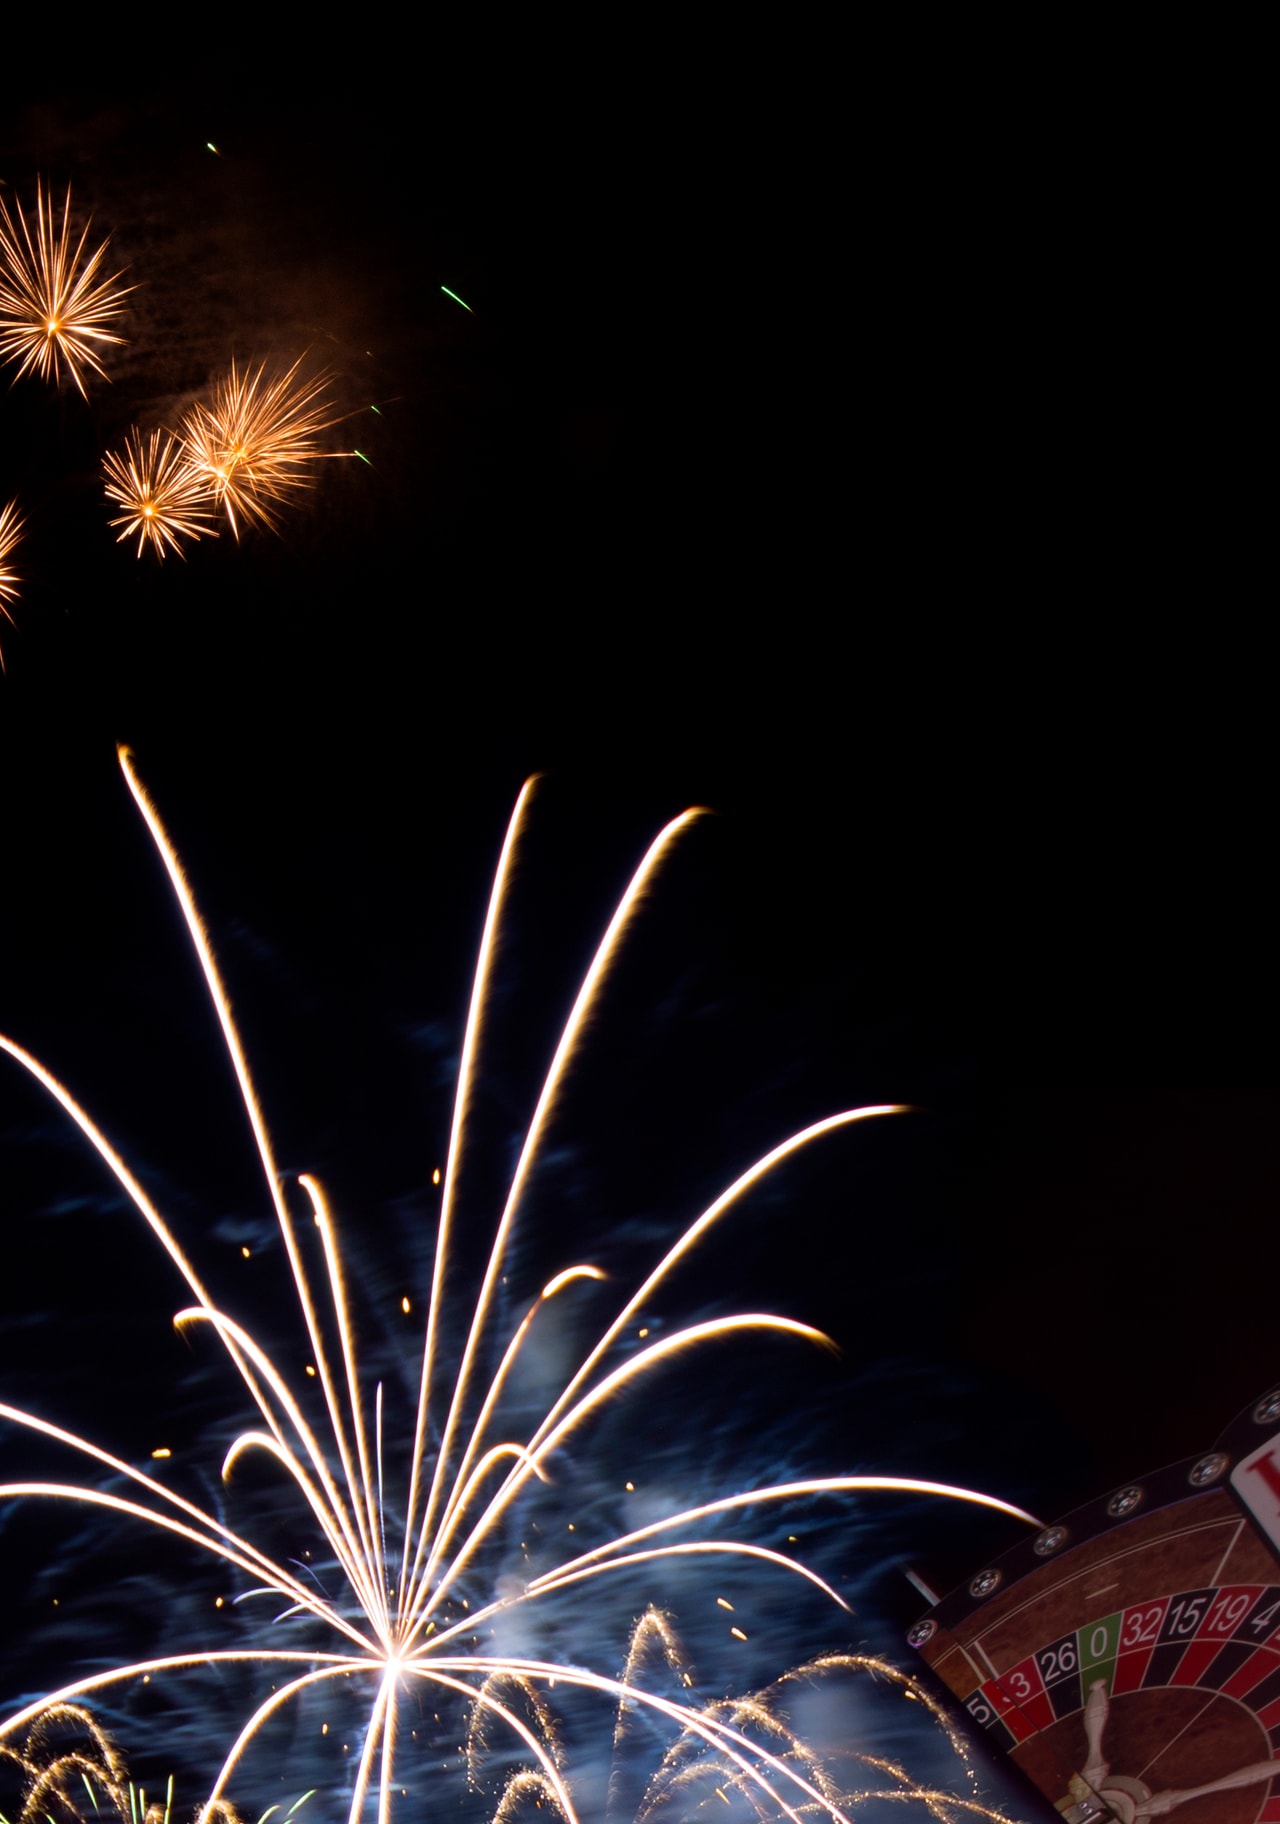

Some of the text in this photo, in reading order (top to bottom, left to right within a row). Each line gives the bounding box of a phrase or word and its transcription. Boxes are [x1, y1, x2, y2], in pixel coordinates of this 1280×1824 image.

[1122, 1607, 1163, 1647] 32
[1167, 1597, 1208, 1636] 15
[1207, 1594, 1250, 1632] 19
[1250, 1600, 1280, 1634] 4
[1090, 1626, 1108, 1658] 0
[1040, 1641, 1077, 1682] 26
[1008, 1671, 1032, 1699] 3
